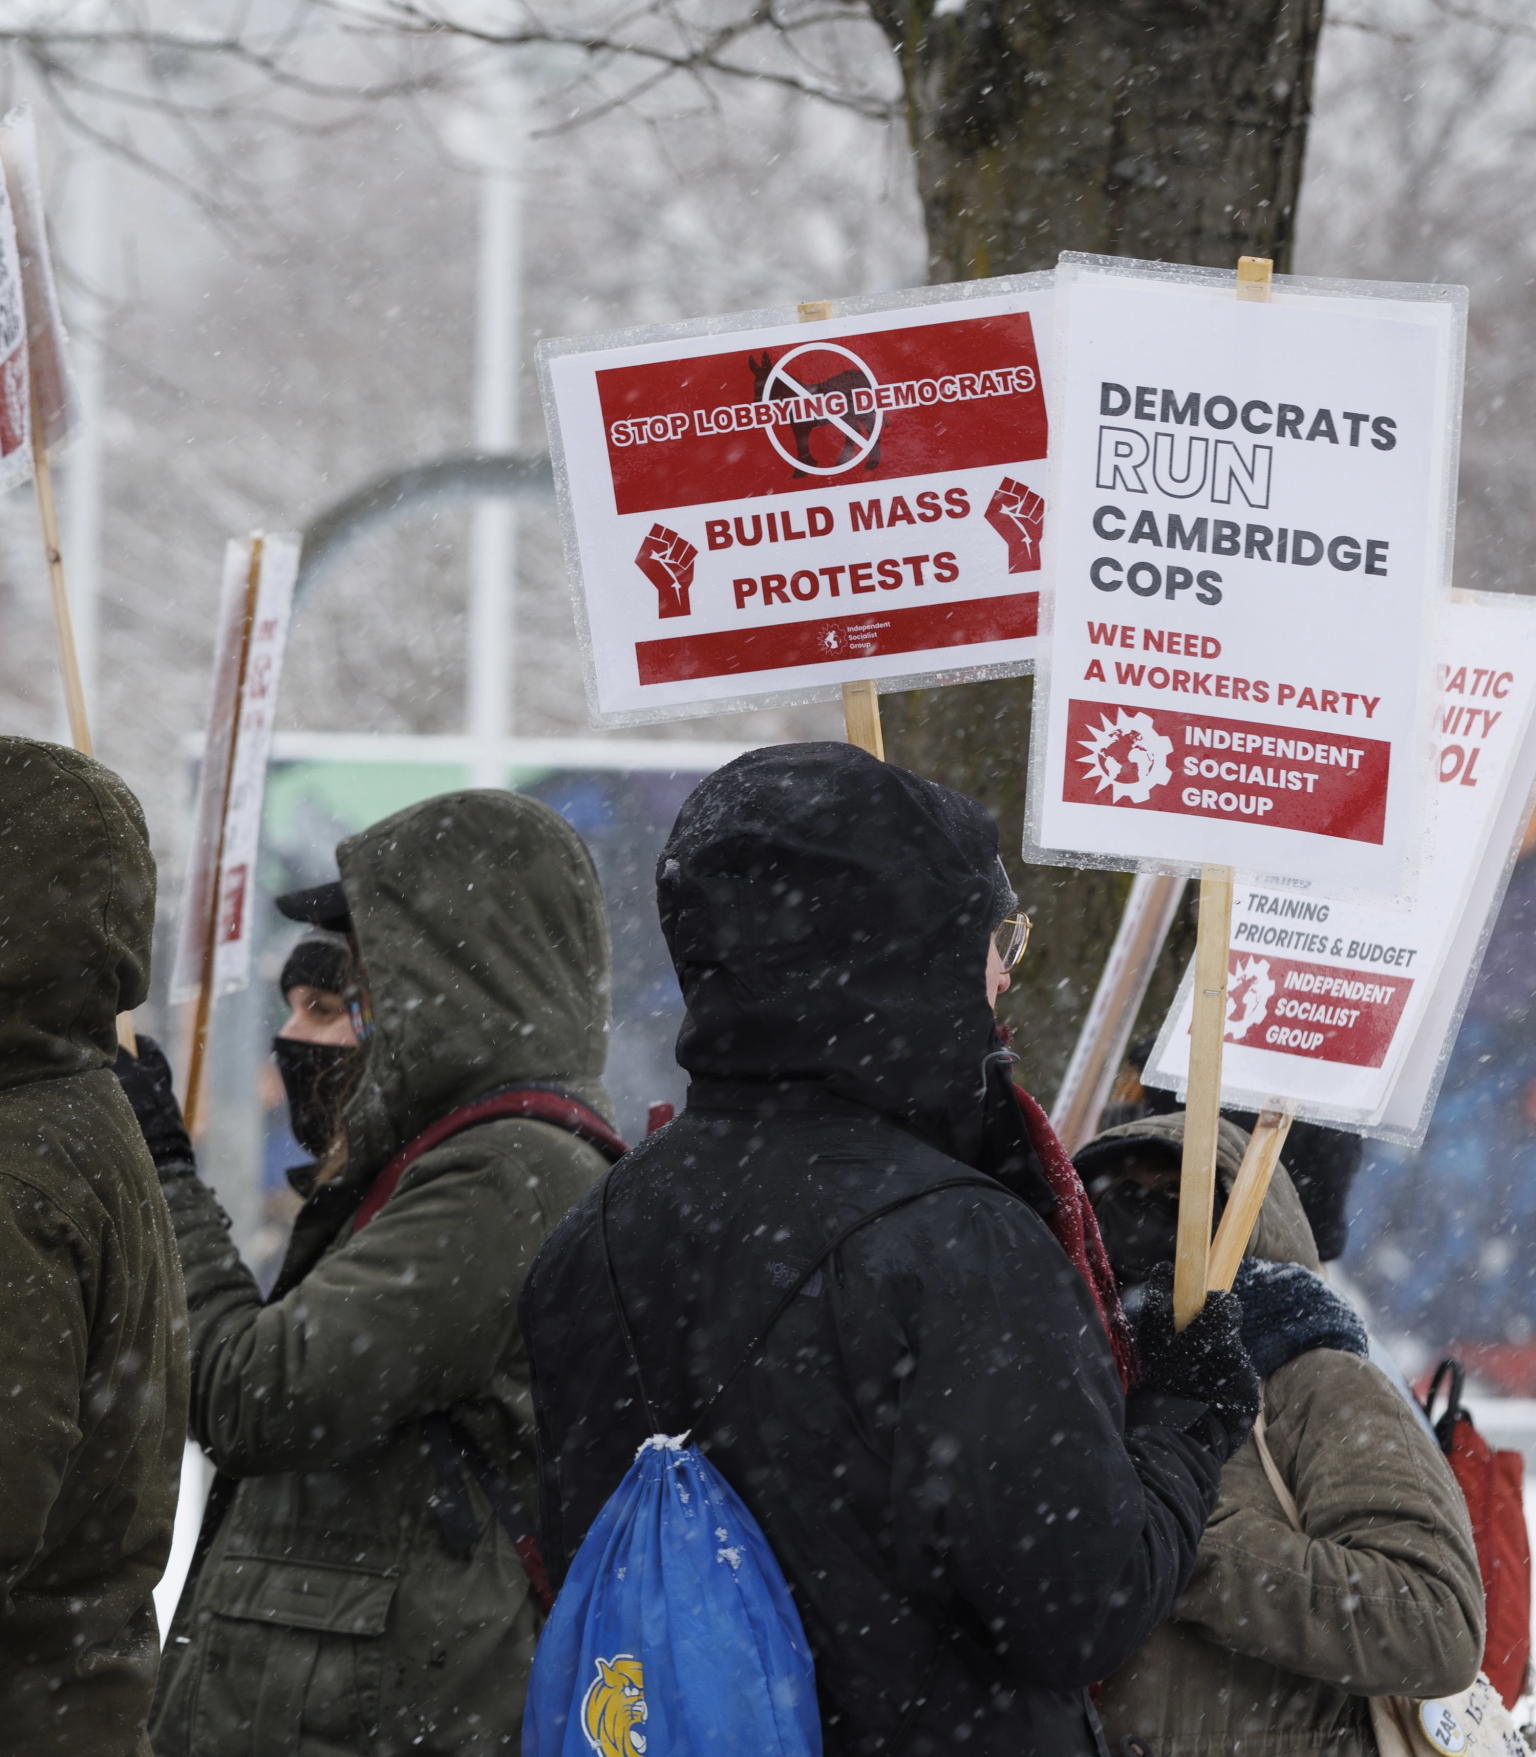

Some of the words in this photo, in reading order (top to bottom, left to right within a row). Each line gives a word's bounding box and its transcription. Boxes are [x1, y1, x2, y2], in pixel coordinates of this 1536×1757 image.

[610, 412, 690, 447] STOP
[694, 391, 848, 436] LOBBYING
[853, 366, 1035, 412] DEMOCRATS
[1099, 382, 1398, 451] DEMOCRATS
[1096, 425, 1273, 510] RUN
[705, 505, 835, 551] BUILD
[849, 487, 971, 533] MASS
[1092, 505, 1390, 576] CAMBRIDGE
[732, 551, 961, 609] PROTESTS
[1090, 556, 1223, 606] COPS
[847, 621, 891, 632] Independent
[848, 632, 877, 641] Socialist
[1086, 621, 1136, 650] WE
[1143, 629, 1222, 660] NEED
[1083, 659, 1106, 682] A
[1115, 662, 1270, 704] WORKERS
[1277, 684, 1381, 719] PARTY
[1444, 664, 1514, 699] ATIC
[1184, 725, 1365, 770] INDEPENDENT
[1183, 757, 1319, 793] SOCIALIST
[1181, 787, 1274, 817] GROUP
[1247, 893, 1330, 923] TRAINING
[1234, 922, 1329, 954] PRIORITIES
[1330, 938, 1344, 957] &
[1346, 940, 1417, 968] BUDGET
[1284, 970, 1395, 1005] INDEPENDENT
[1275, 998, 1360, 1028] SOCIALIST
[1265, 1025, 1324, 1051] GROUP
[1435, 1709, 1456, 1746] ZAP
